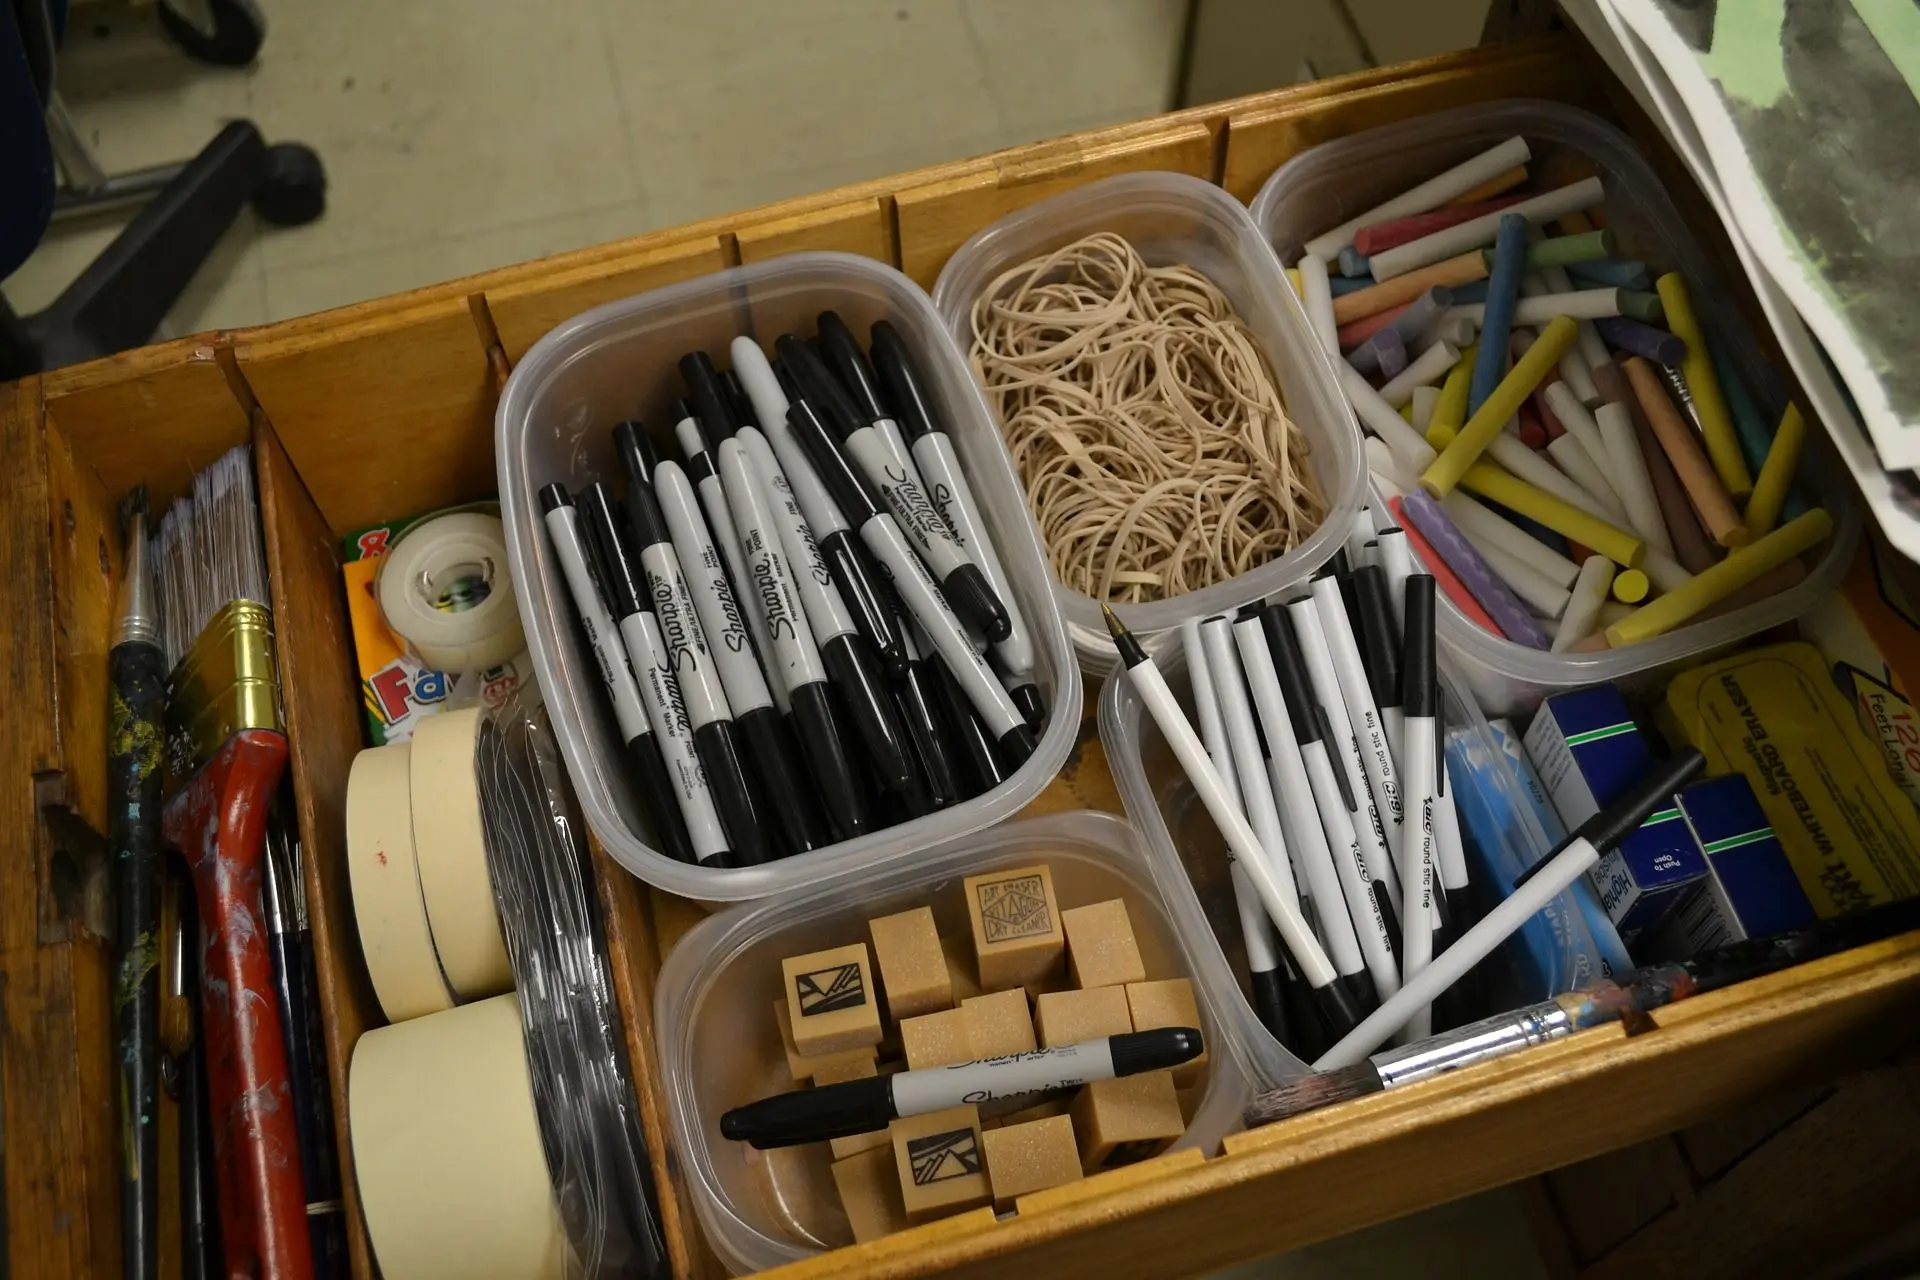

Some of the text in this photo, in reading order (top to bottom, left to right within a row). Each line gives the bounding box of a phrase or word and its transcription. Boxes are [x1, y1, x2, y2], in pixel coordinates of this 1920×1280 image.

[750, 529, 763, 551] POINT
[707, 545, 719, 567] POINT
[754, 558, 796, 640] Sharpie
[656, 584, 697, 672] Sharpie
[710, 579, 753, 653] Sharpie
[648, 667, 676, 738] Permanent Marker
[1721, 674, 1769, 741] ERASER
[1869, 693, 1892, 734] Feet
[1365, 711, 1376, 729] fine
[1372, 731, 1383, 750] stic
[1376, 750, 1391, 776] round
[1759, 742, 1836, 858] WHITEBOARD
[1424, 836, 1432, 864] round
[1654, 854, 1673, 864] Open
[1423, 867, 1431, 886] stic
[1654, 858, 1681, 871] Push To
[1422, 888, 1430, 908] fine
[1602, 869, 1633, 913] Highla
[1367, 887, 1379, 914] round
[1376, 913, 1385, 932] stic
[1382, 933, 1391, 953] fine
